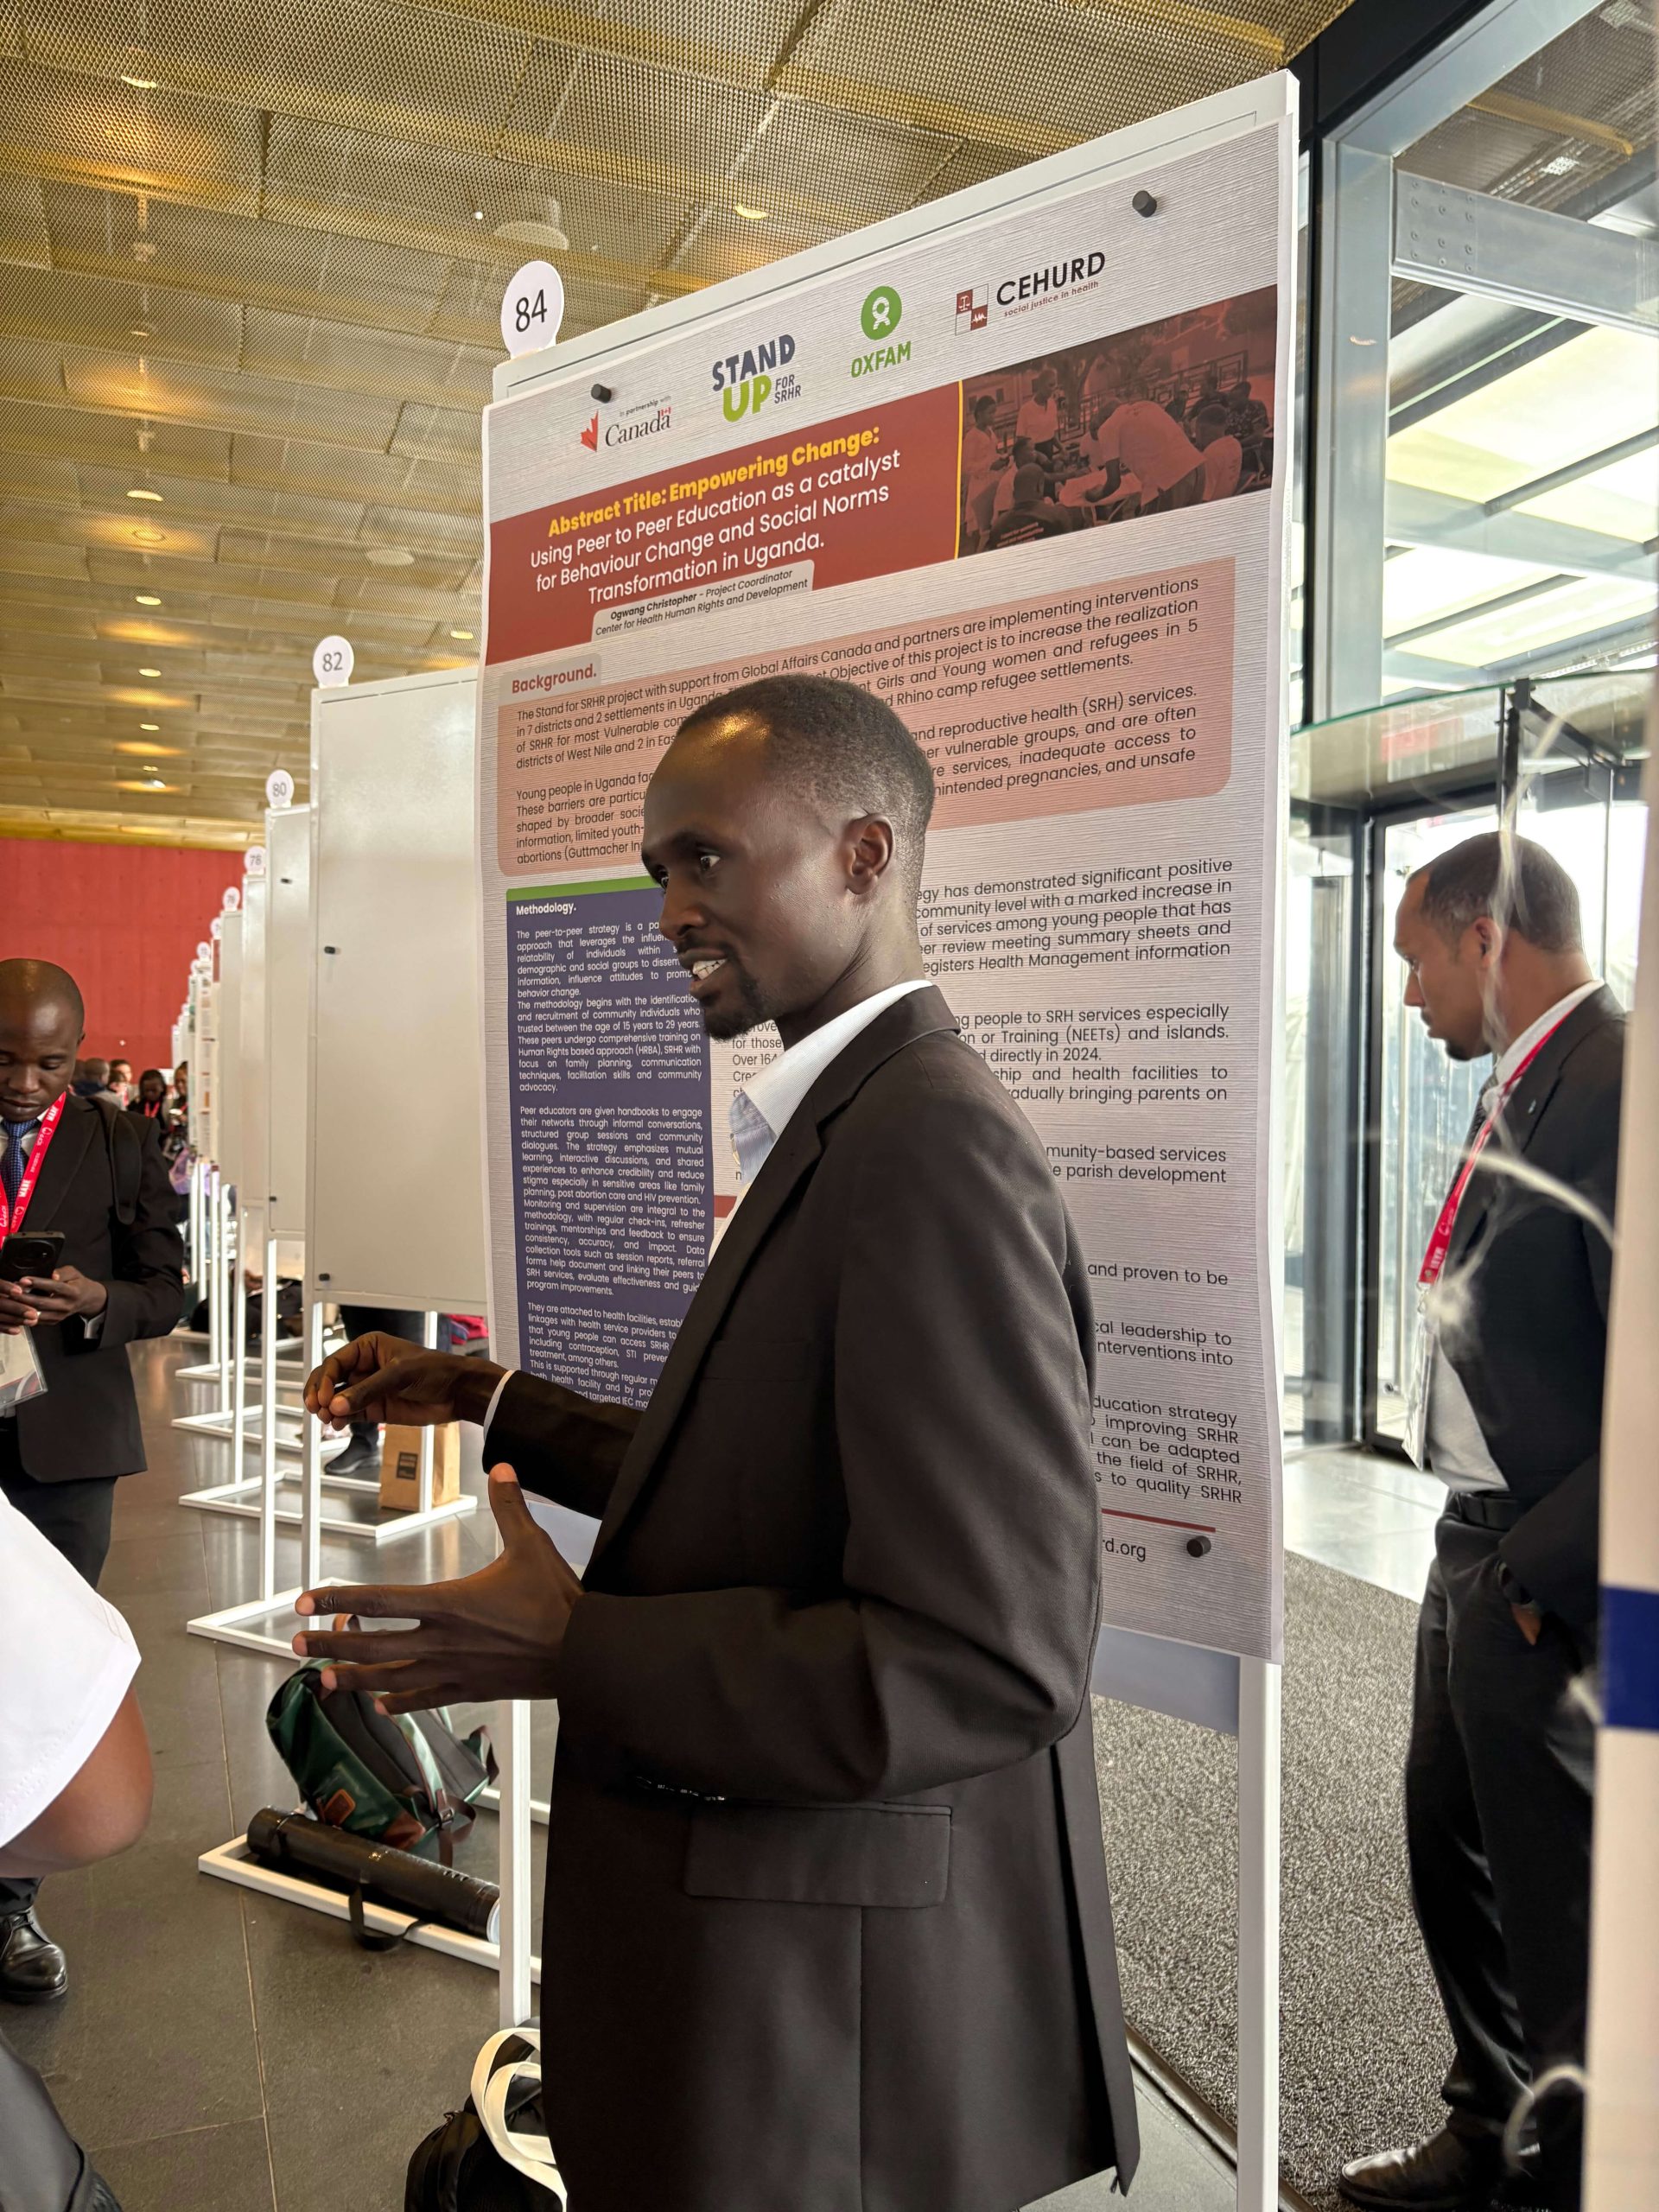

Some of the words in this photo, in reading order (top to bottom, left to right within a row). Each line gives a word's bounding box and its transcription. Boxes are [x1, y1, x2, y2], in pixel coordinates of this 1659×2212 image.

[996, 251, 1106, 308] CEHURD
[516, 289, 548, 333] 84
[1003, 302, 1029, 317] social
[1029, 294, 1058, 311] justice
[1060, 290, 1069, 299] in
[1071, 280, 1098, 296] health
[712, 334, 796, 391] STAND
[850, 340, 912, 378] OXFAM
[774, 385, 802, 404] SRHR
[775, 375, 795, 390] FOR
[722, 375, 772, 423] UP
[605, 409, 671, 447] Canada
[548, 500, 620, 537] Abstract
[622, 488, 666, 515] Title:
[669, 454, 788, 502] Empowering
[791, 426, 879, 466] Change:
[530, 543, 572, 568] Using
[576, 532, 612, 556] Peer
[614, 527, 632, 544] to
[635, 515, 672, 539] Peer
[677, 489, 766, 527] Education
[771, 481, 794, 501] as
[798, 476, 811, 493] a
[817, 448, 900, 488] catalyst
[536, 573, 557, 592] for
[560, 550, 641, 585] Behaviour
[645, 531, 714, 563] Change
[718, 516, 754, 543] and
[760, 499, 817, 532] Social
[823, 485, 889, 517] Norms
[588, 558, 717, 604] Transformation
[722, 551, 738, 571] in
[743, 531, 824, 569] Uganda.
[596, 623, 622, 636] Center
[624, 619, 635, 629] for
[637, 612, 663, 626] Health
[664, 607, 695, 619] Human
[696, 598, 724, 613] Rights
[725, 592, 744, 606] and
[745, 578, 808, 601] Development
[609, 605, 645, 621] Ogwang
[645, 593, 697, 612] Christopher
[705, 582, 736, 597] Project
[737, 569, 792, 589] Coordinator
[517, 710, 534, 721] The
[535, 702, 563, 718] Stand
[564, 700, 579, 712] for
[580, 695, 605, 709] SRHR
[607, 688, 643, 708] project
[644, 683, 666, 697] with
[668, 674, 710, 694] support
[712, 670, 739, 684] from
[741, 659, 779, 678] Global
[780, 653, 818, 671] Affairs
[821, 643, 871, 663] Canada
[874, 634, 900, 652] and
[903, 625, 960, 651] partners
[962, 620, 986, 635] are
[988, 599, 1091, 630] implementing
[1095, 577, 1198, 608] interventions
[830, 659, 888, 681] Objective
[893, 653, 904, 668] of
[907, 649, 931, 665] this
[934, 638, 983, 664] project
[986, 636, 997, 650] is
[1000, 634, 1015, 647] to
[1018, 621, 1083, 644] increase
[1085, 615, 1111, 631] the
[1115, 599, 1198, 626] realization
[322, 652, 344, 672] 82
[512, 662, 596, 694] Background.
[938, 712, 1027, 740] reproductive
[1030, 702, 1077, 722] health
[1082, 690, 1123, 717] (SRH)
[1128, 684, 1197, 707] services.
[516, 788, 546, 801] Young
[548, 782, 582, 800] people
[584, 779, 593, 791] in
[595, 773, 635, 792] Uganda
[935, 774, 1002, 796] nintended
[1006, 761, 1101, 791] pregnancies,
[1104, 753, 1136, 772] and
[1140, 747, 1195, 767] unsafe
[272, 782, 287, 797] 80
[516, 804, 544, 817] These
[547, 798, 585, 813] barriers
[588, 796, 606, 807] are
[609, 790, 645, 808] particu
[944, 885, 969, 898] has
[973, 871, 1076, 895] demonstrated
[1081, 864, 1162, 888] significant
[1167, 857, 1233, 881] positive
[516, 902, 576, 916] Methodology.
[916, 901, 991, 918] community
[994, 896, 1027, 912] level
[1029, 893, 1060, 909] with
[1064, 894, 1074, 906] a
[1077, 885, 1138, 905] marked
[1141, 881, 1212, 900] increase
[1217, 878, 1231, 893] in
[517, 1023, 543, 1033] trusted
[544, 1022, 578, 1033] between
[579, 1021, 593, 1032] the
[594, 1022, 611, 1033] age
[612, 1020, 620, 1031] of
[622, 1020, 630, 1030] 15
[632, 1021, 653, 1033] years
[654, 1020, 664, 1029] to
[664, 1019, 675, 1029] 29
[677, 1020, 700, 1031] years.
[974, 1010, 1022, 1029] people
[1027, 1010, 1041, 1024] to
[1046, 1008, 1073, 1023] SRH
[1077, 1006, 1141, 1022] services
[1146, 1002, 1230, 1023] especially
[752, 1037, 782, 1048] those
[989, 1047, 1042, 1065] directly
[1046, 1046, 1058, 1061] in
[1062, 1046, 1102, 1061] 2024.
[733, 1054, 758, 1065] Over
[519, 1082, 558, 1094] advocacy.
[519, 1105, 537, 1115] Peer
[538, 1105, 576, 1115] educators
[578, 1107, 592, 1116] are
[594, 1105, 615, 1118] given
[617, 1106, 659, 1116] handbooks
[661, 1107, 670, 1116] to
[671, 1108, 702, 1119] engage
[1046, 1143, 1154, 1163] munity-based
[1159, 1146, 1226, 1162] services
[1065, 1163, 1113, 1180] parish
[1117, 1164, 1226, 1185] development
[1087, 1263, 1116, 1276] and
[1122, 1266, 1179, 1281] proven
[1184, 1268, 1200, 1283] to
[1205, 1268, 1228, 1286] be
[1097, 1340, 1196, 1361] nterventions
[1201, 1348, 1233, 1365] into
[1093, 1395, 1162, 1414] ducation
[1167, 1404, 1237, 1427] strategy
[1105, 1414, 1186, 1441] improving
[1197, 1426, 1238, 1444] SRHR
[1096, 1451, 1122, 1466] the
[1129, 1454, 1163, 1472] field
[1171, 1461, 1187, 1476] of
[1196, 1465, 1242, 1485] SRHR,
